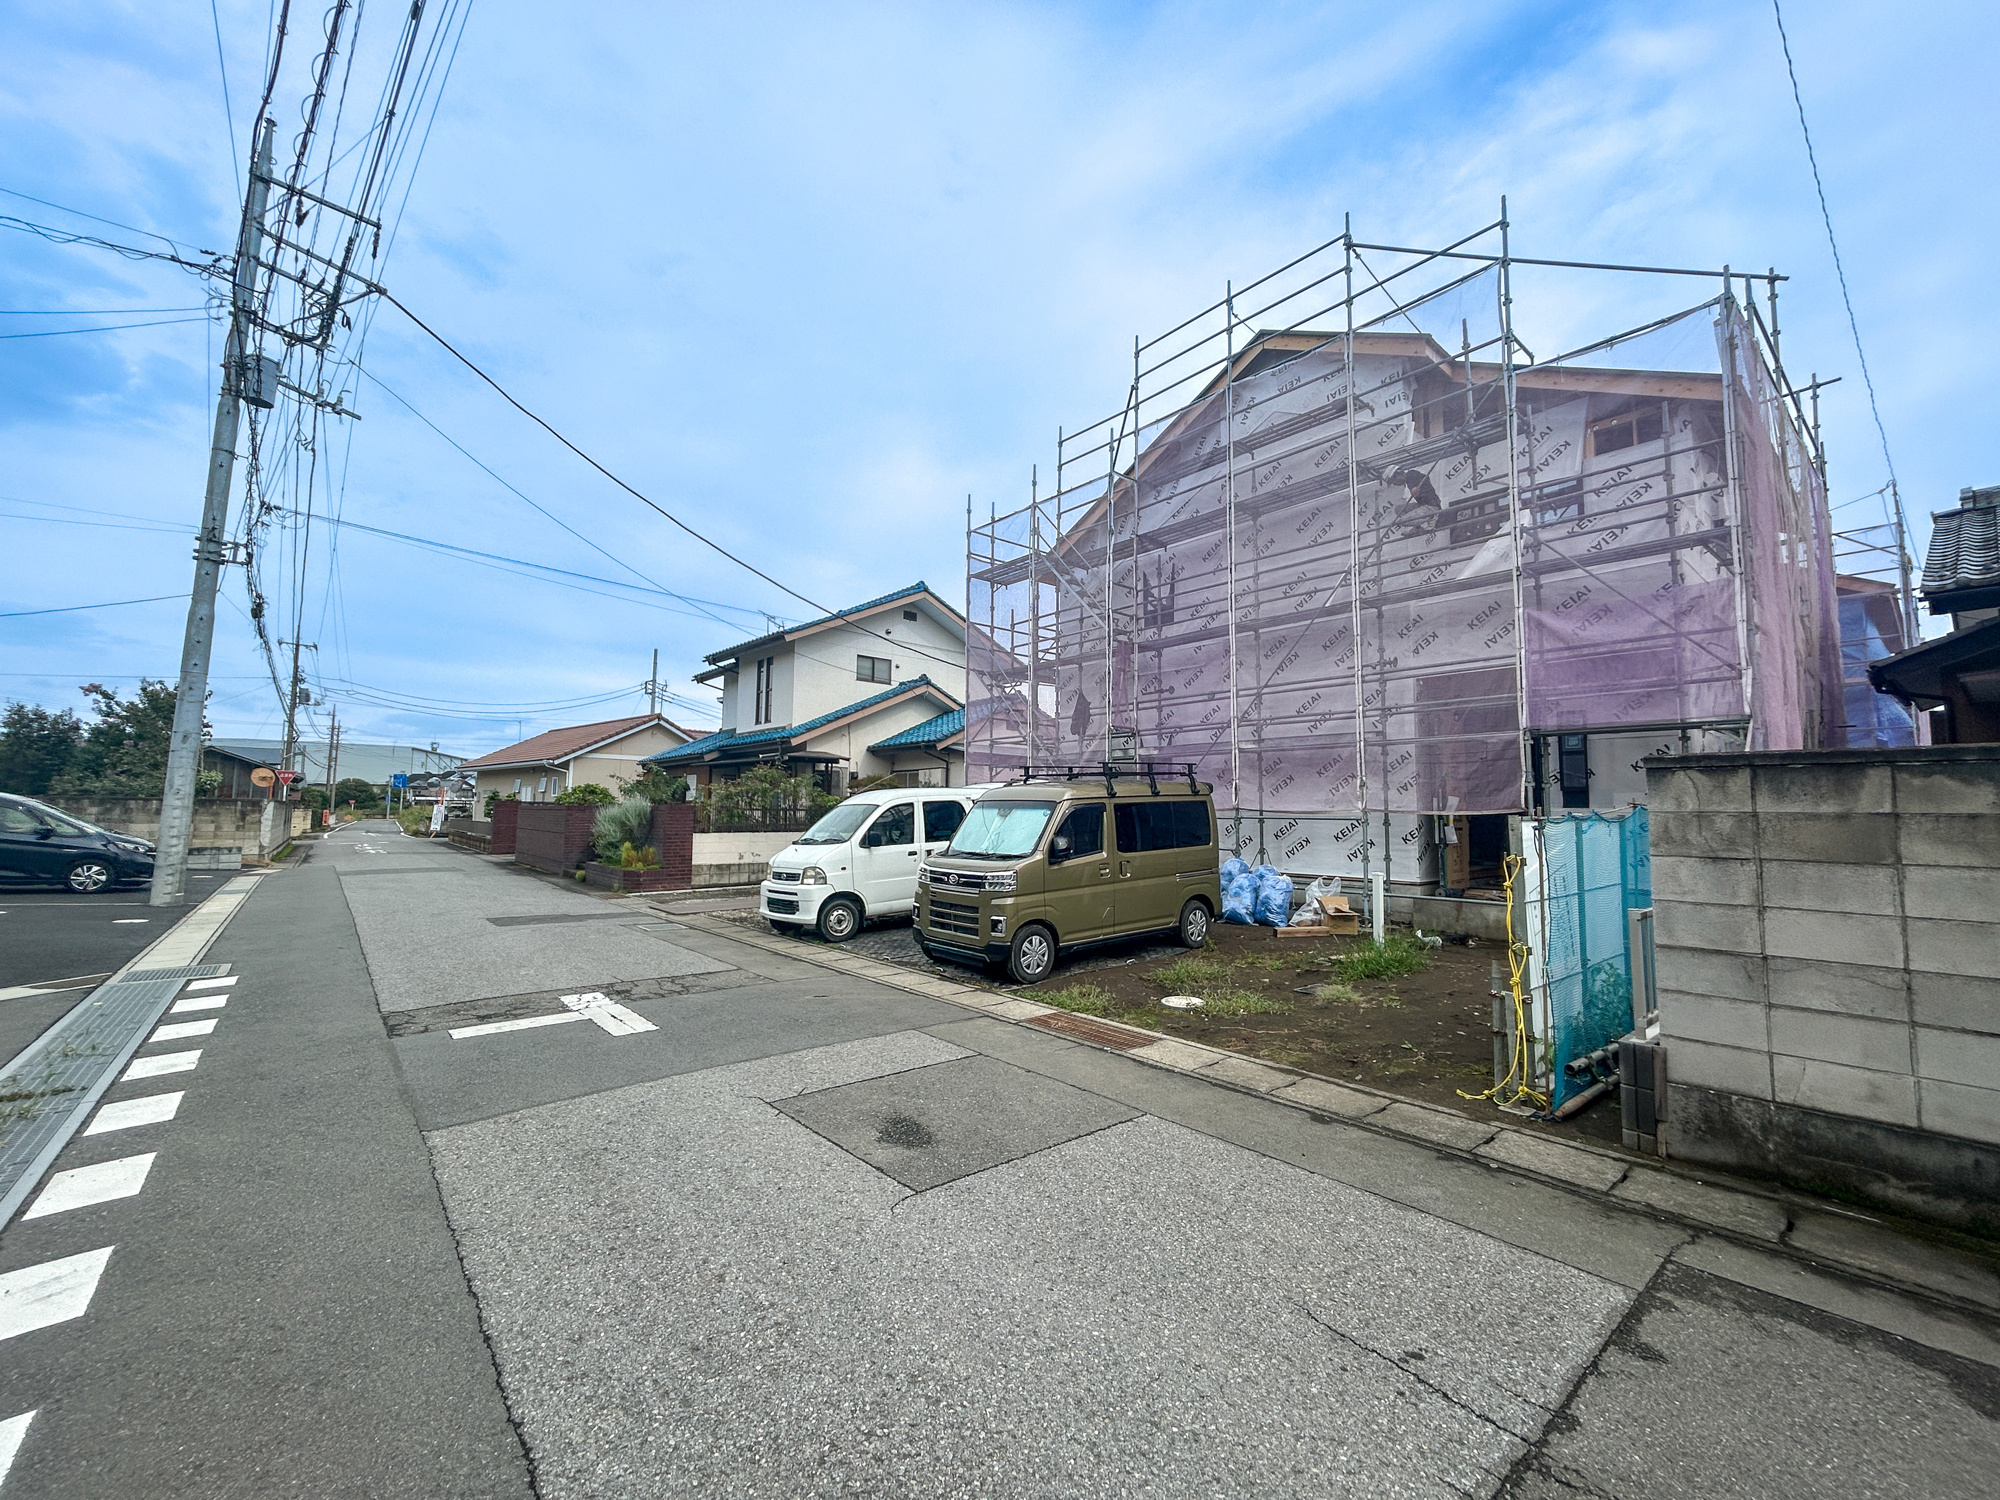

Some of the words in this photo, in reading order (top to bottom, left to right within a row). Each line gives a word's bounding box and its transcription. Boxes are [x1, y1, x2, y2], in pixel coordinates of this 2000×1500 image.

[1194, 436, 1206, 456] EIAI
[1314, 440, 1340, 468] KEIAI
[1258, 461, 1281, 487] KEIAI
[1295, 507, 1321, 533] KEIAI
[1201, 539, 1222, 562] KEIAI
[1467, 600, 1501, 629] KEIAI
[1263, 635, 1287, 659] KEIAI
[1321, 625, 1348, 650] KEIAI
[1183, 668, 1203, 689] KEIAI
[1295, 692, 1321, 715] KEIAI
[1316, 753, 1343, 777] KEIAI
[1269, 774, 1294, 796] KEIAI
[1328, 772, 1356, 796] KEIAI
[1273, 818, 1298, 840] KEIAI
[1284, 836, 1310, 859] KEIAI
